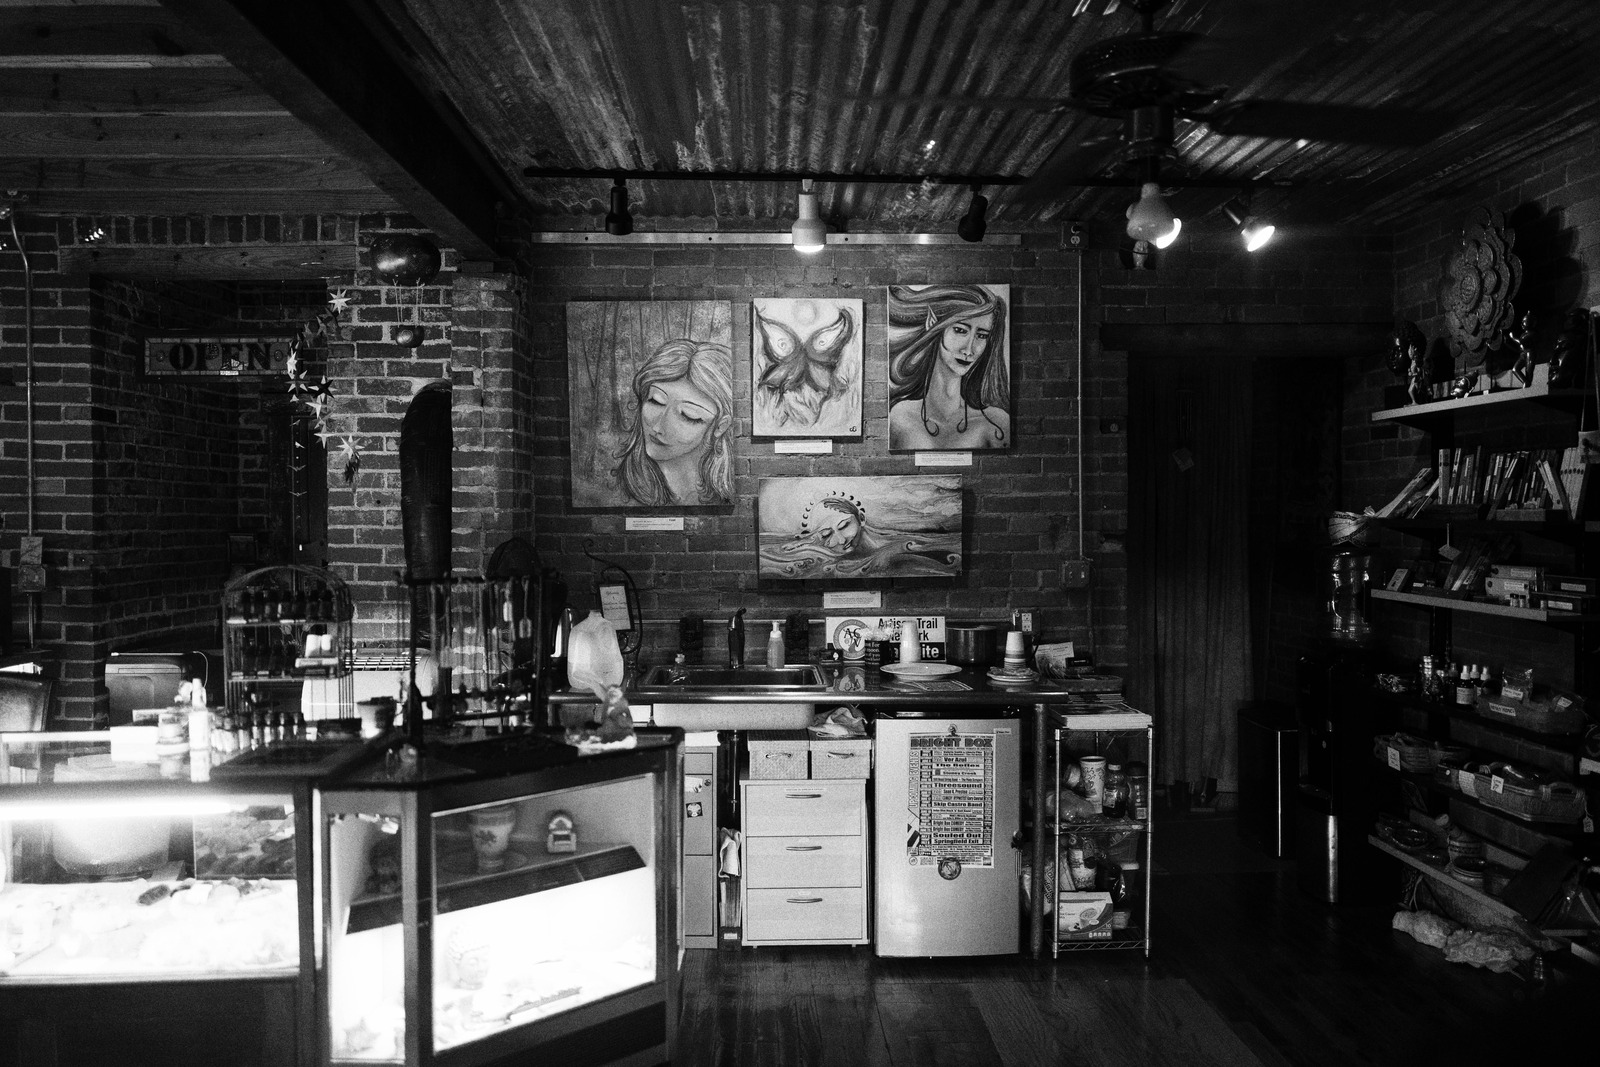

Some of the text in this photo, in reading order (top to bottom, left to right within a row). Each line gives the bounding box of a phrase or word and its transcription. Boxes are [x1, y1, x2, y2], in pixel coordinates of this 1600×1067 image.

[169, 343, 271, 371] OPEN
[916, 618, 938, 629] Trail
[910, 737, 993, 747] BRIGHT BOX
